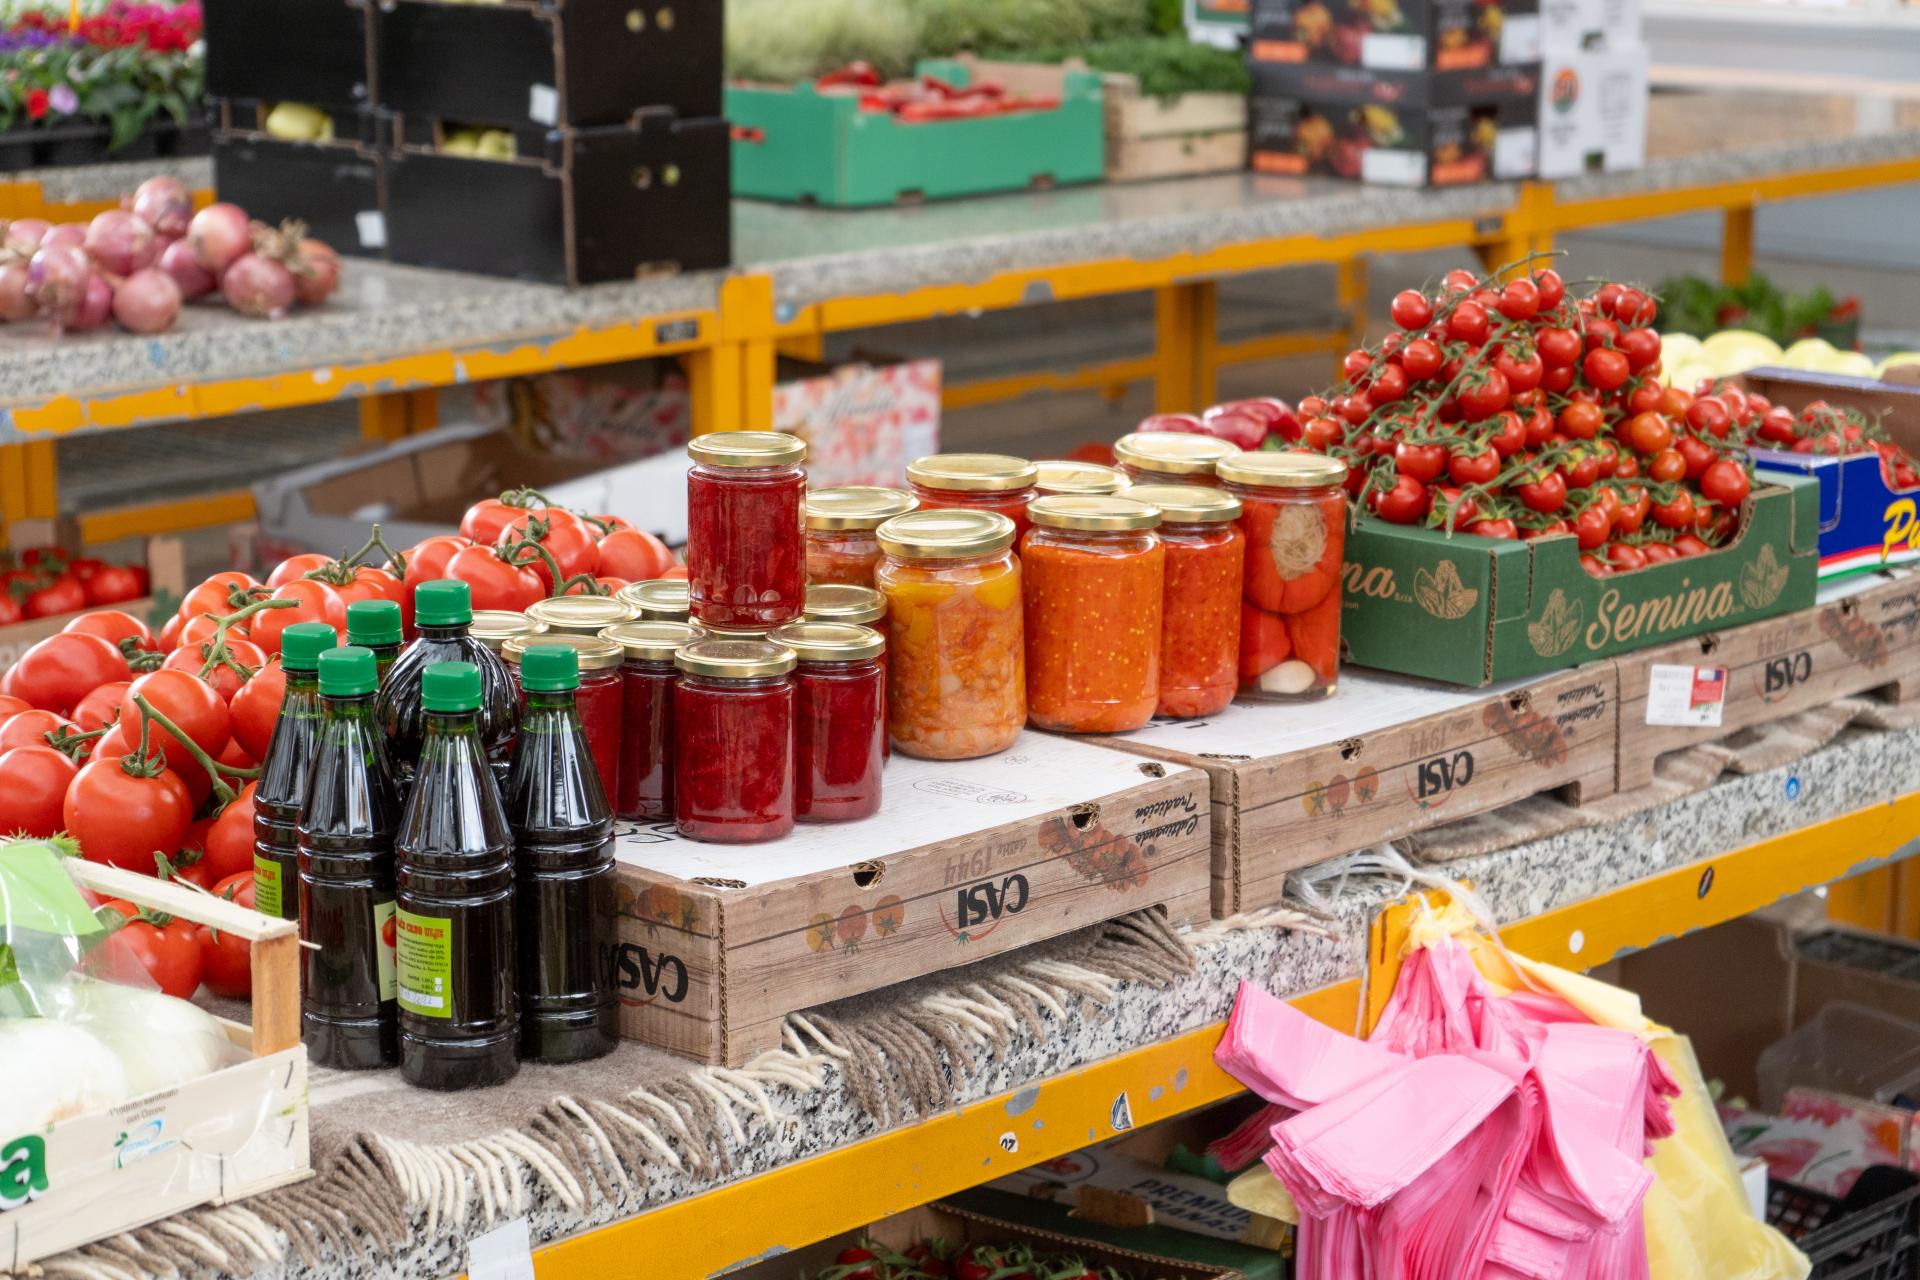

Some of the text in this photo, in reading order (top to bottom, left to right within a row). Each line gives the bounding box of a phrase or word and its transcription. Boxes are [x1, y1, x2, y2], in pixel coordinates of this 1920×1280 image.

[1585, 577, 1734, 650] Semina
[1764, 652, 1812, 693] CASI
[1409, 726, 1446, 758] 1944
[1417, 750, 1474, 799] CASI
[1135, 792, 1197, 824] Tradición
[1135, 814, 1199, 847] Cultivando
[943, 846, 994, 886] 1944
[957, 873, 1029, 930] CASI
[616, 942, 689, 1003] CAS
[1118, 1188, 1242, 1233] NANAS
